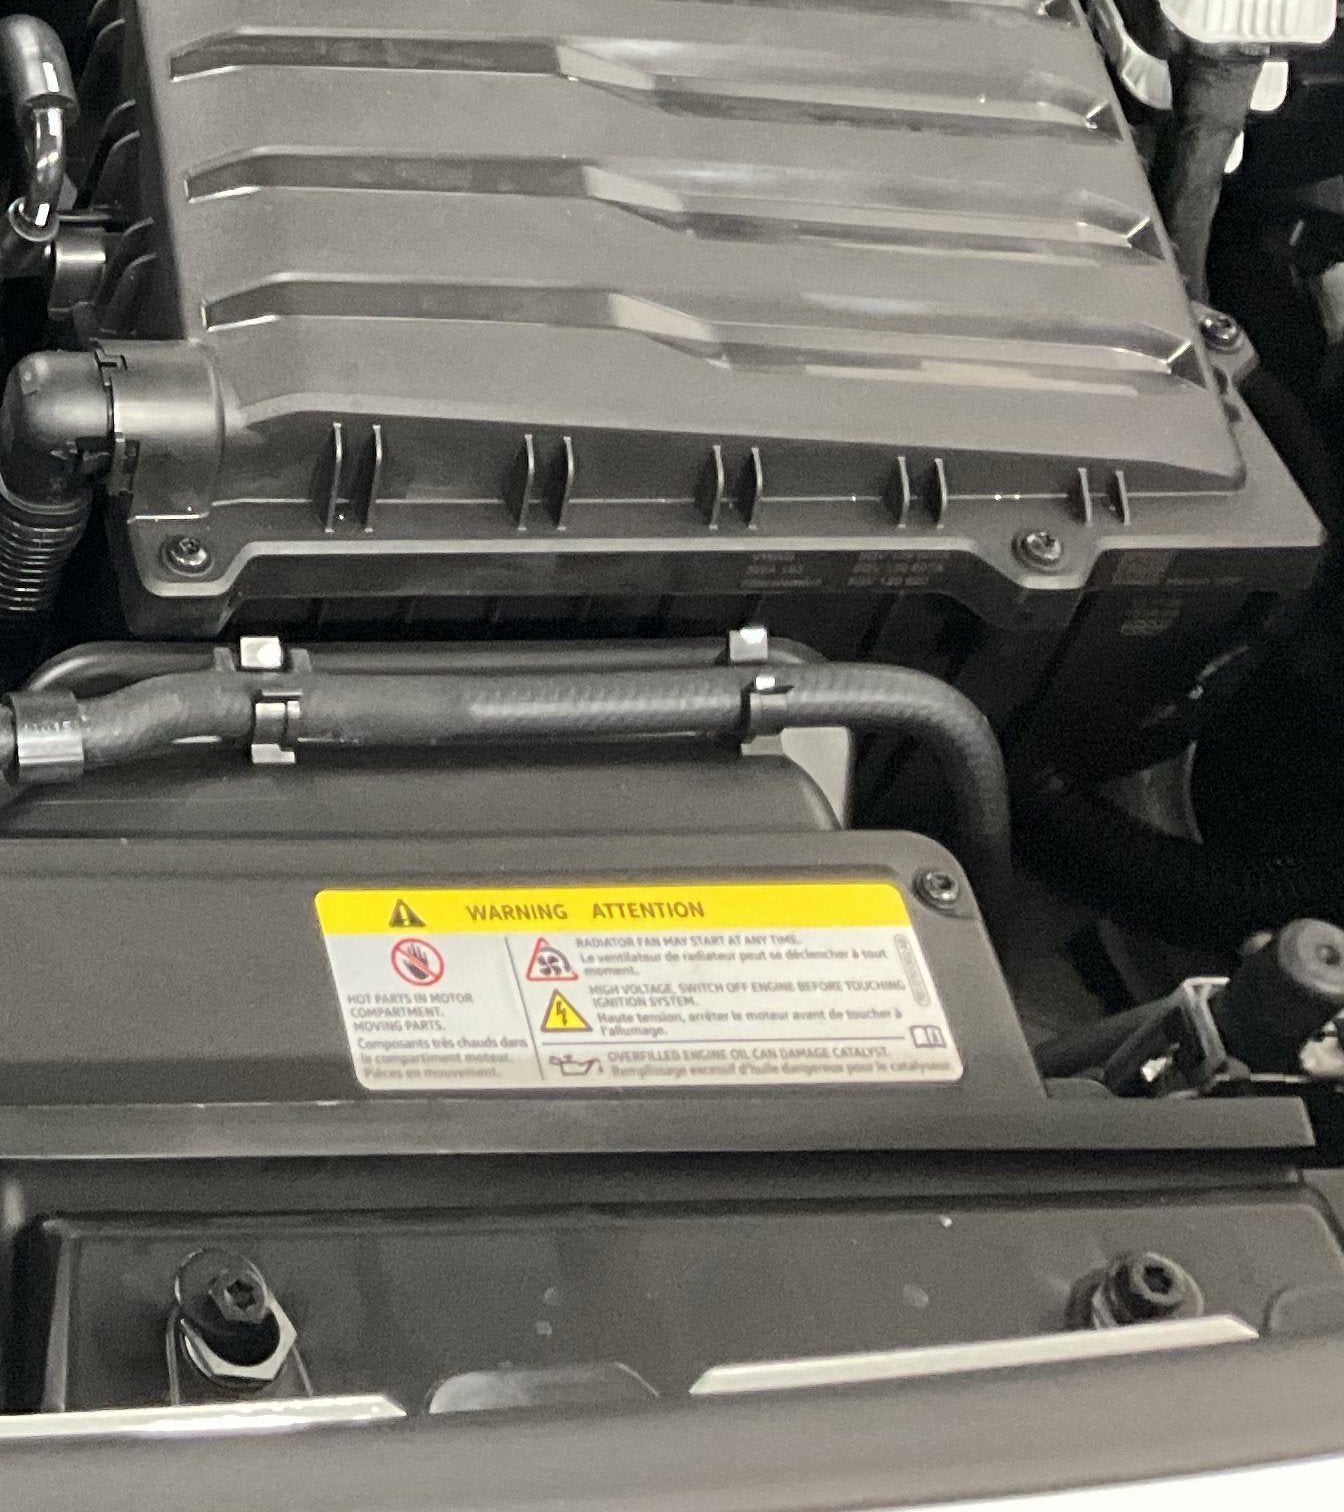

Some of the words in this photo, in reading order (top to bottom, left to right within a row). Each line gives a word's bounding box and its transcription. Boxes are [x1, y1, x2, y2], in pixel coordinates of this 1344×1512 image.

[465, 903, 568, 921] WARNING
[592, 901, 705, 919] ATTENTION
[576, 937, 635, 948] RADIATOR
[637, 937, 661, 947] FAN
[663, 936, 688, 947] MAY
[690, 935, 724, 946] START
[728, 935, 742, 945] AT
[744, 935, 767, 945] ANY
[580, 953, 596, 963] Le
[599, 951, 662, 963] ventilateur
[664, 951, 680, 962] de
[683, 949, 736, 961] radiateur
[740, 949, 766, 962] peut
[769, 951, 783, 960] se
[785, 948, 849, 960] déclencher
[862, 949, 887, 959] tout
[589, 985, 620, 995] HIGH
[678, 983, 724, 994] SWITCH
[726, 982, 748, 992] OFF
[751, 982, 795, 992] ENGINE
[797, 981, 843, 992] BEFORE
[845, 980, 906, 991] TOUCHING
[347, 993, 373, 1004] HOT
[374, 992, 412, 1004] PARTS
[413, 992, 428, 1003] IN
[429, 992, 474, 1004] MOTOR
[593, 997, 647, 1008] IGNITION
[597, 1012, 634, 1023] Haute
[745, 1009, 790, 1020] moteur
[792, 1009, 826, 1020] avant
[828, 1008, 844, 1019] de
[846, 1008, 893, 1019] toucher
[353, 1021, 403, 1032] MOVING
[358, 1039, 431, 1051] Composants
[432, 1037, 455, 1049] très
[456, 1037, 499, 1049] chauds
[500, 1037, 529, 1049] dans
[608, 1051, 681, 1062] OVERFILLED
[683, 1050, 727, 1061] ENGINE
[729, 1049, 750, 1060] OIL
[753, 1048, 777, 1059] CAN
[779, 1047, 830, 1059] DAMAGE
